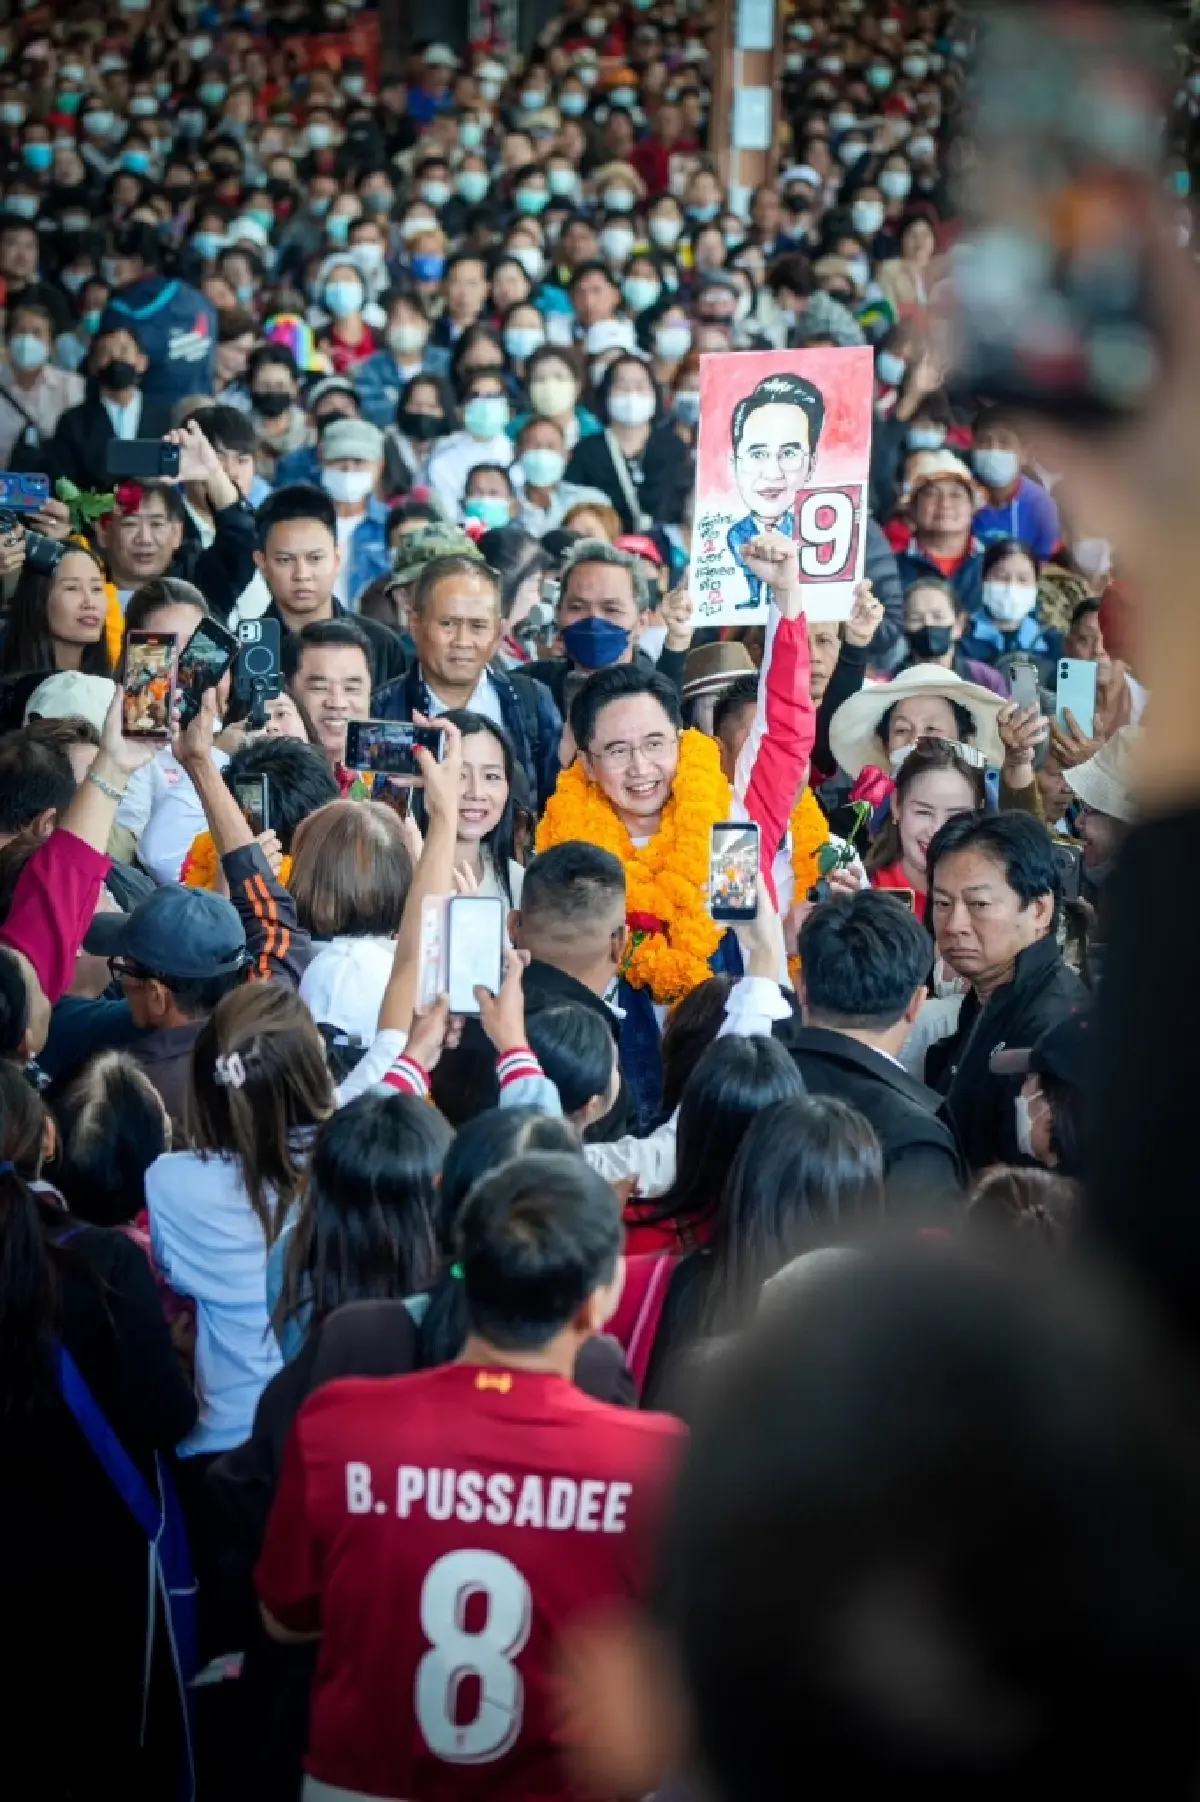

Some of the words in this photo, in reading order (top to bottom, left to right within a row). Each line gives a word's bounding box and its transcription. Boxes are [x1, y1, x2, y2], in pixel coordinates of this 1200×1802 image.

[798, 490, 855, 577] 9
[345, 1461, 388, 1515] B.
[396, 1464, 633, 1534] PUSSADEE
[414, 1549, 533, 1764] 8
